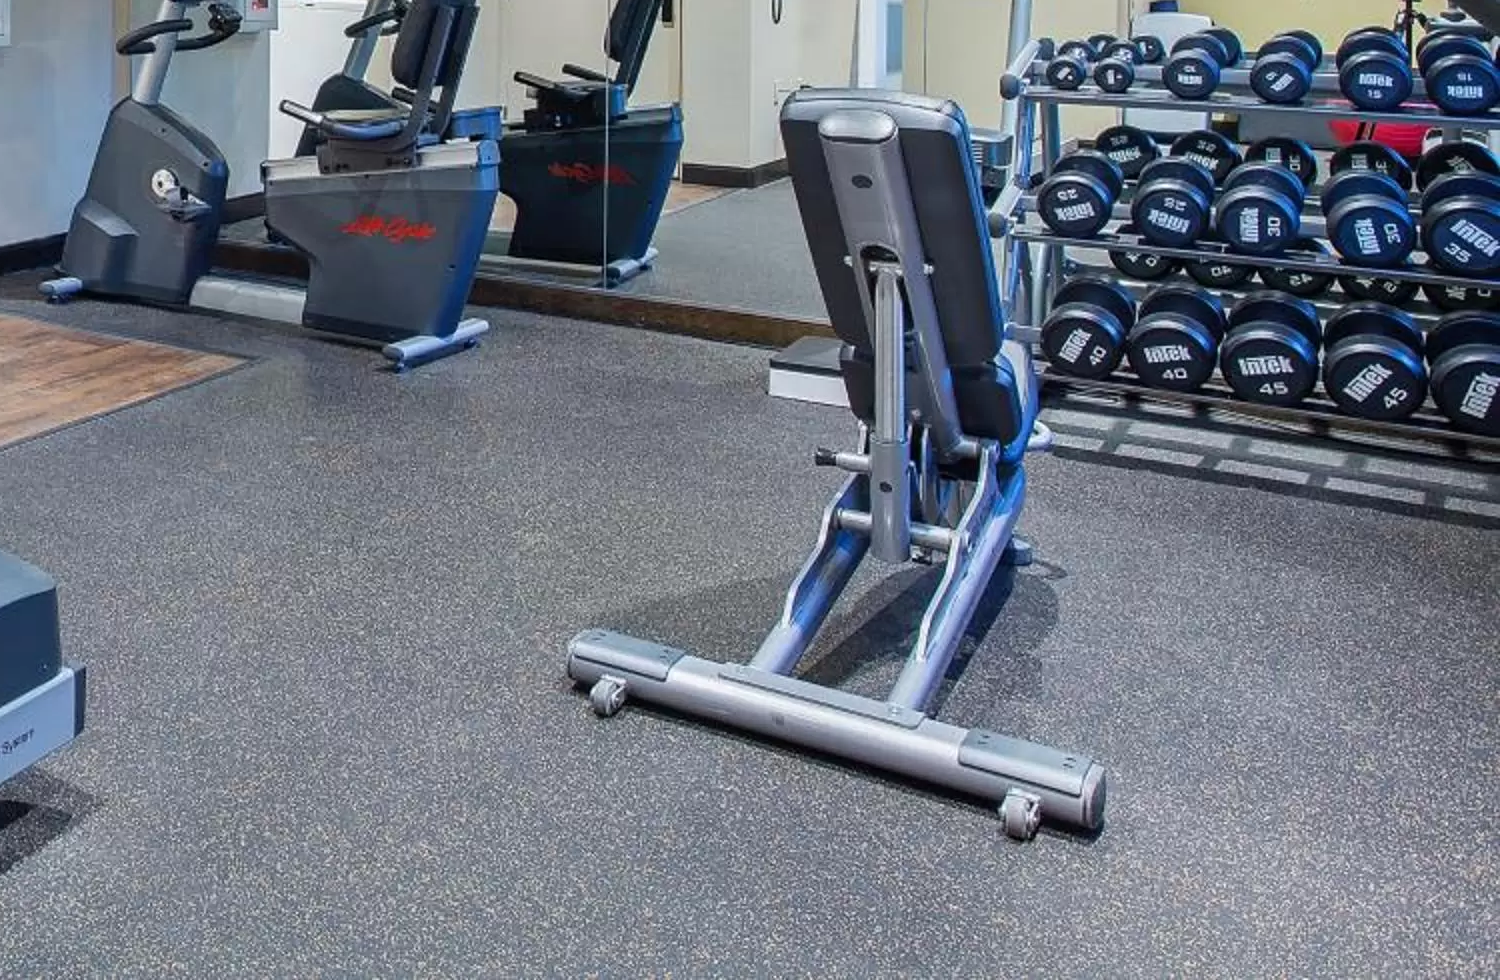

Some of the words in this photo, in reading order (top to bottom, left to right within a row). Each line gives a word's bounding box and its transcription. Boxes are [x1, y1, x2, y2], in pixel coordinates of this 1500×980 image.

[1267, 216, 1281, 238] 30
[1383, 222, 1401, 245] 30
[1444, 243, 1472, 264] 35
[1088, 345, 1107, 366] 40
[1161, 367, 1188, 380] 40
[1258, 381, 1289, 396] 45
[1382, 386, 1408, 410] 45
